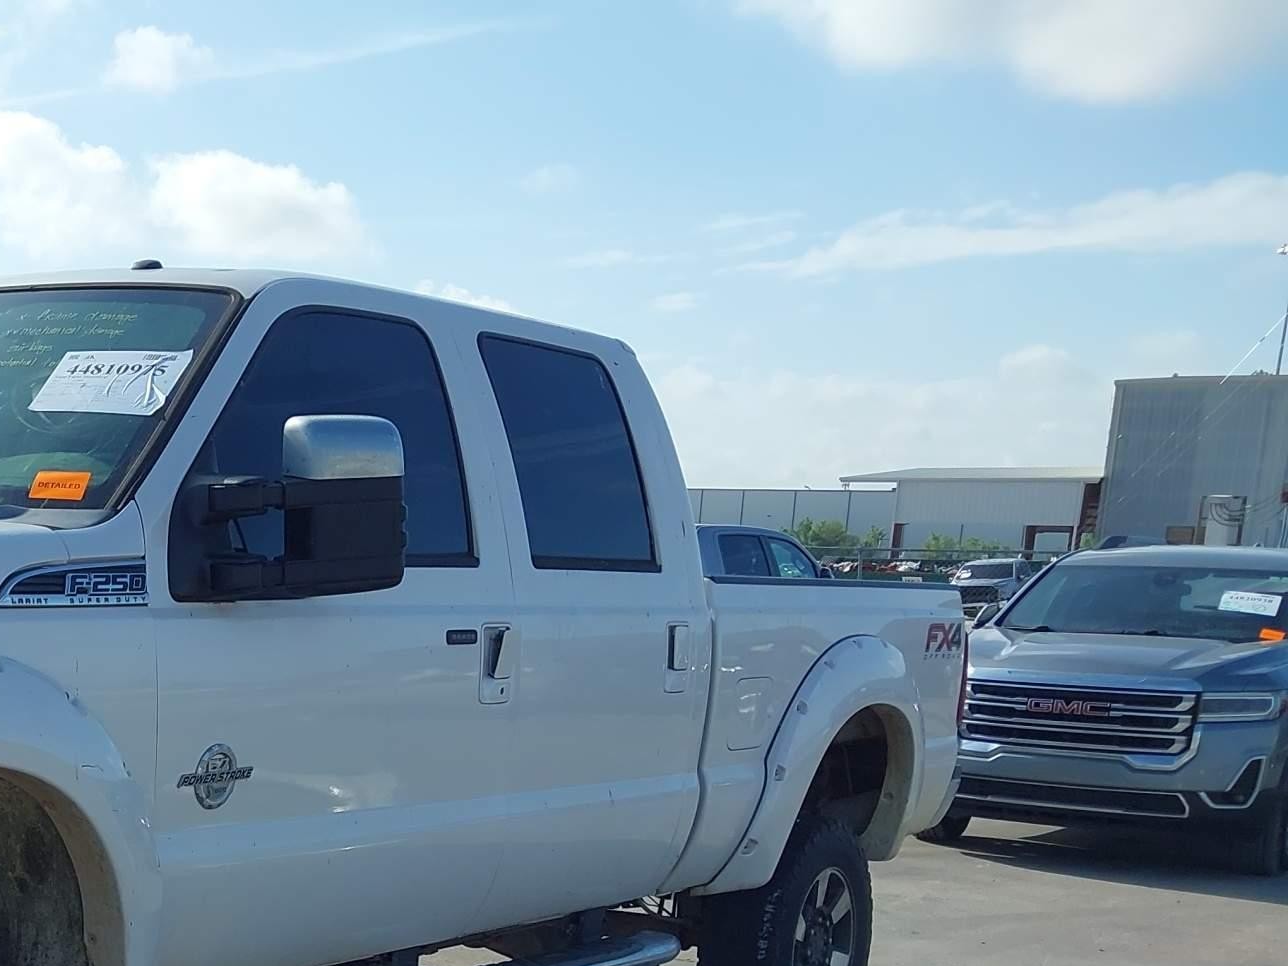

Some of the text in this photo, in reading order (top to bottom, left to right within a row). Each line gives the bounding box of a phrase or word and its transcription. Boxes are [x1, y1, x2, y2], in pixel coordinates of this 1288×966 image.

[66, 363, 169, 376] 44810975
[37, 481, 81, 490] DETAILED
[65, 573, 147, 596] F-250
[11, 597, 49, 605] LARIAT
[115, 595, 146, 603] DUTY
[925, 623, 961, 652] FX4
[1027, 698, 1111, 717] GMC
[180, 767, 254, 787] POWER STROKE
